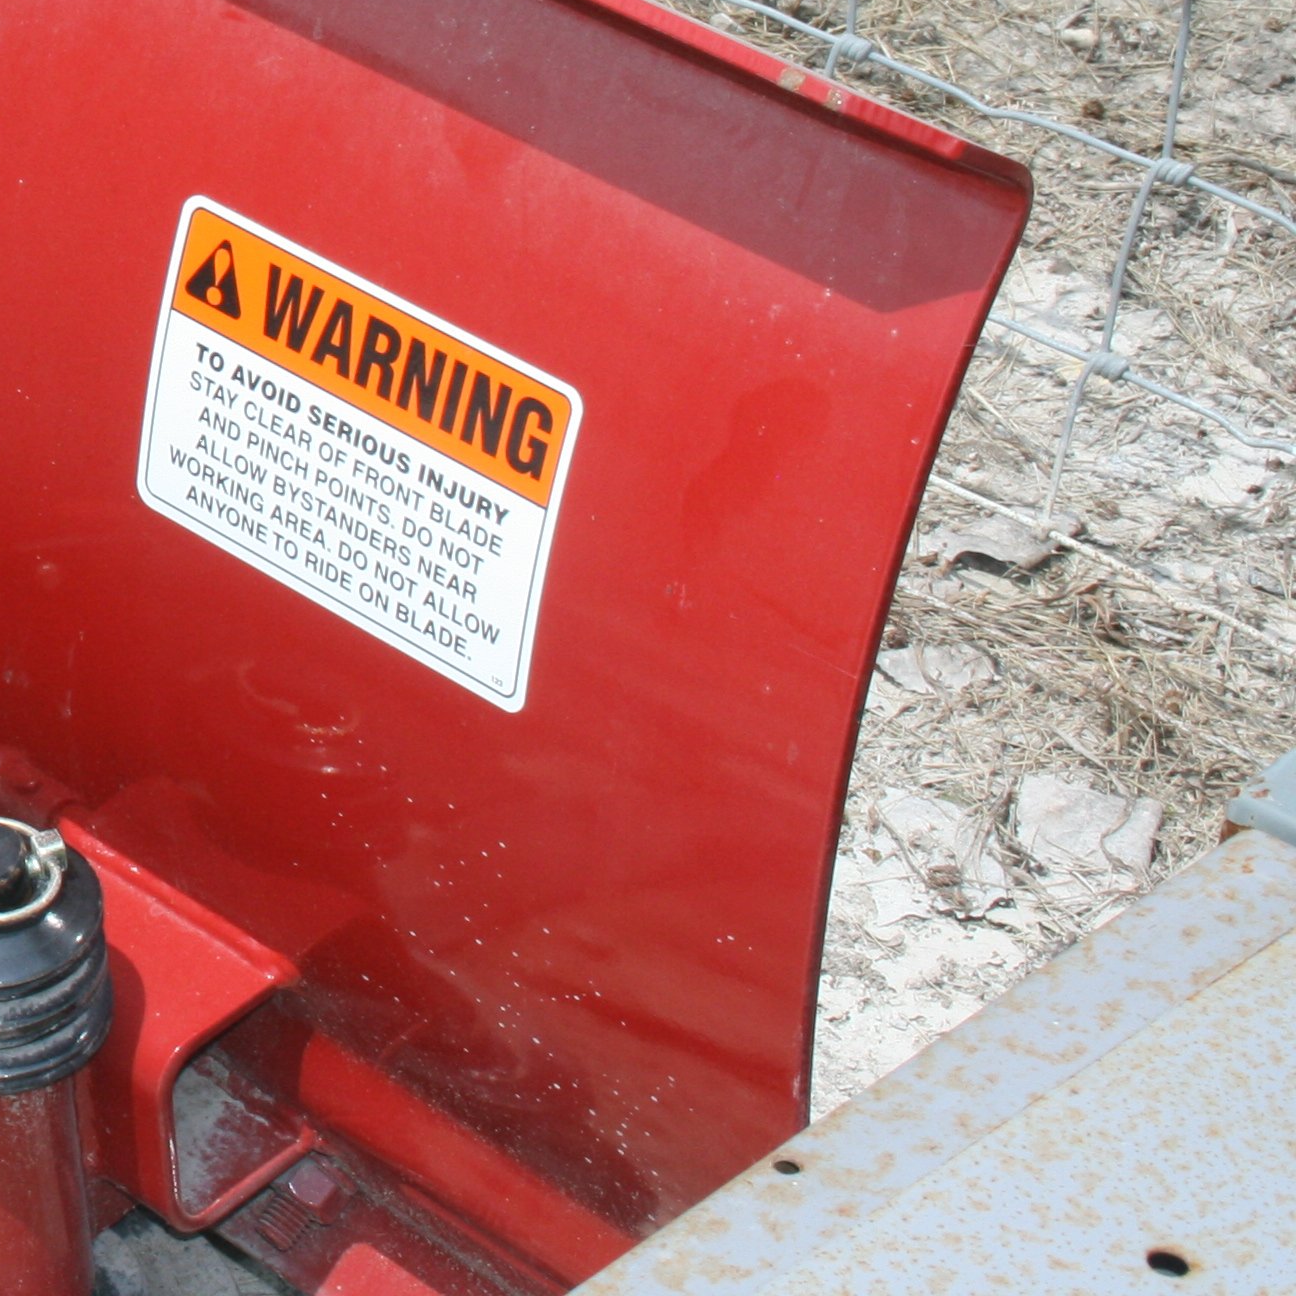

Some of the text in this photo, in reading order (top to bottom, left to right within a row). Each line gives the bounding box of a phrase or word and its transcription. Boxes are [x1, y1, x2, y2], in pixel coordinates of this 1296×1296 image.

[189, 370, 504, 558] STAY CLEAR OF FRONT BLADE
[196, 342, 510, 527] TO AVOID SERIOUS INJURY
[263, 262, 554, 482] WARNING
[169, 444, 501, 646] WORKING AREA. DO NOT ALLOW
[185, 485, 473, 662] ANYONE TO RIDE ON BLADE.
[195, 434, 478, 604] ALLOW BYSTANDERS NEAR
[198, 406, 485, 576] AND PINCH POINTS. DO NOT
